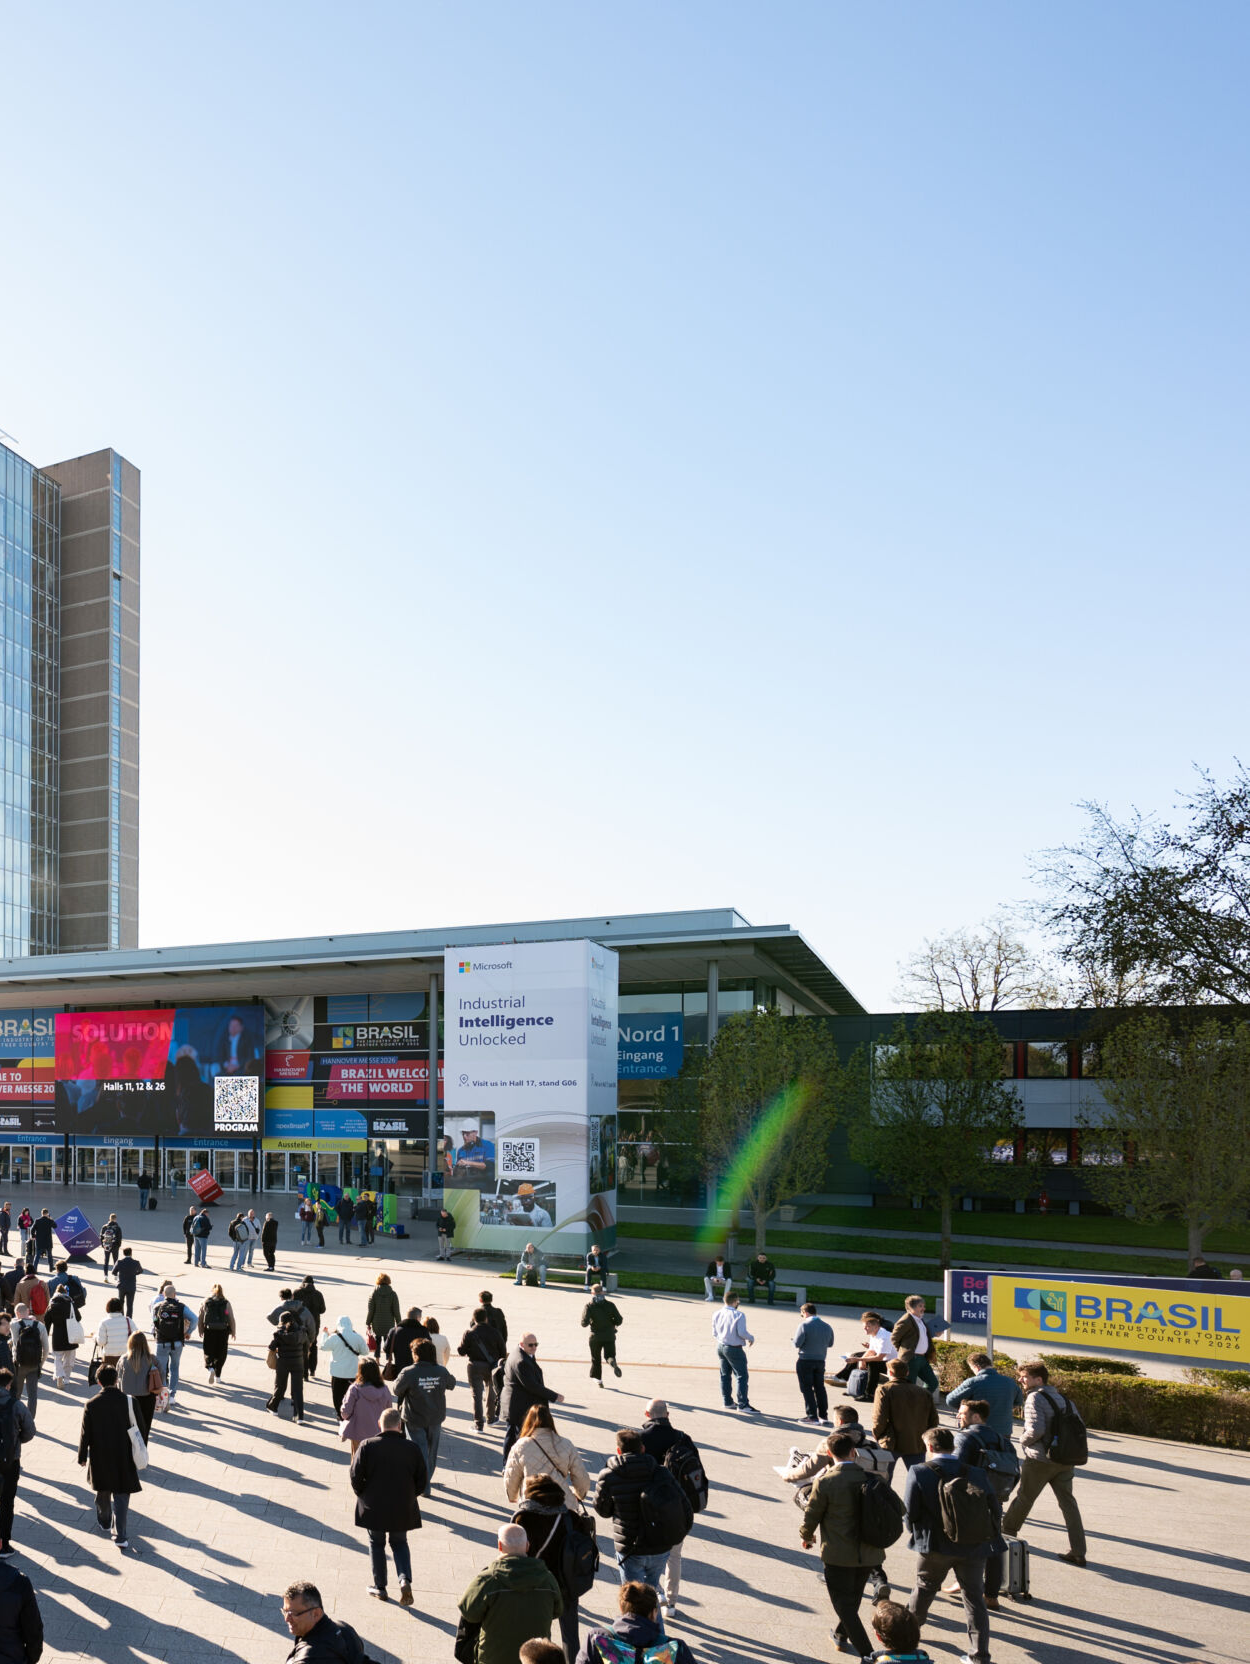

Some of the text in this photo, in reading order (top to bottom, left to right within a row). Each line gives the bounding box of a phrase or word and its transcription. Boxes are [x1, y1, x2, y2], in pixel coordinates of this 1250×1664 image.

[473, 961, 512, 971] Microsoft
[459, 995, 525, 1010] Industrial
[459, 1015, 554, 1030] Intelligence
[356, 1026, 419, 1039] BRASIL
[618, 1025, 665, 1042] Nord
[671, 1026, 678, 1041] 1
[459, 1032, 526, 1046] Unlocked
[617, 1051, 663, 1062] Eingang
[341, 1069, 384, 1078] BRAZIL
[617, 1064, 667, 1073] Entrance
[10, 1073, 21, 1081] TO
[15, 1085, 42, 1093] MESSE
[104, 1082, 123, 1091] Halls
[125, 1083, 134, 1092] 11,
[146, 1082, 153, 1090] &
[155, 1083, 165, 1091] 26
[341, 1083, 413, 1093] THE WORLD
[214, 1123, 258, 1132] PROGRAM
[373, 1122, 408, 1131] BRASIL
[104, 1137, 133, 1146] Eingang
[962, 1310, 986, 1319] Fix it
[1075, 1295, 1241, 1334] BRASIL
[1103, 1323, 1166, 1335] INDUSTRY
[1197, 1332, 1240, 1342] TODAY
[1075, 1327, 1240, 1350] PARTNER COUNTRY 2026
